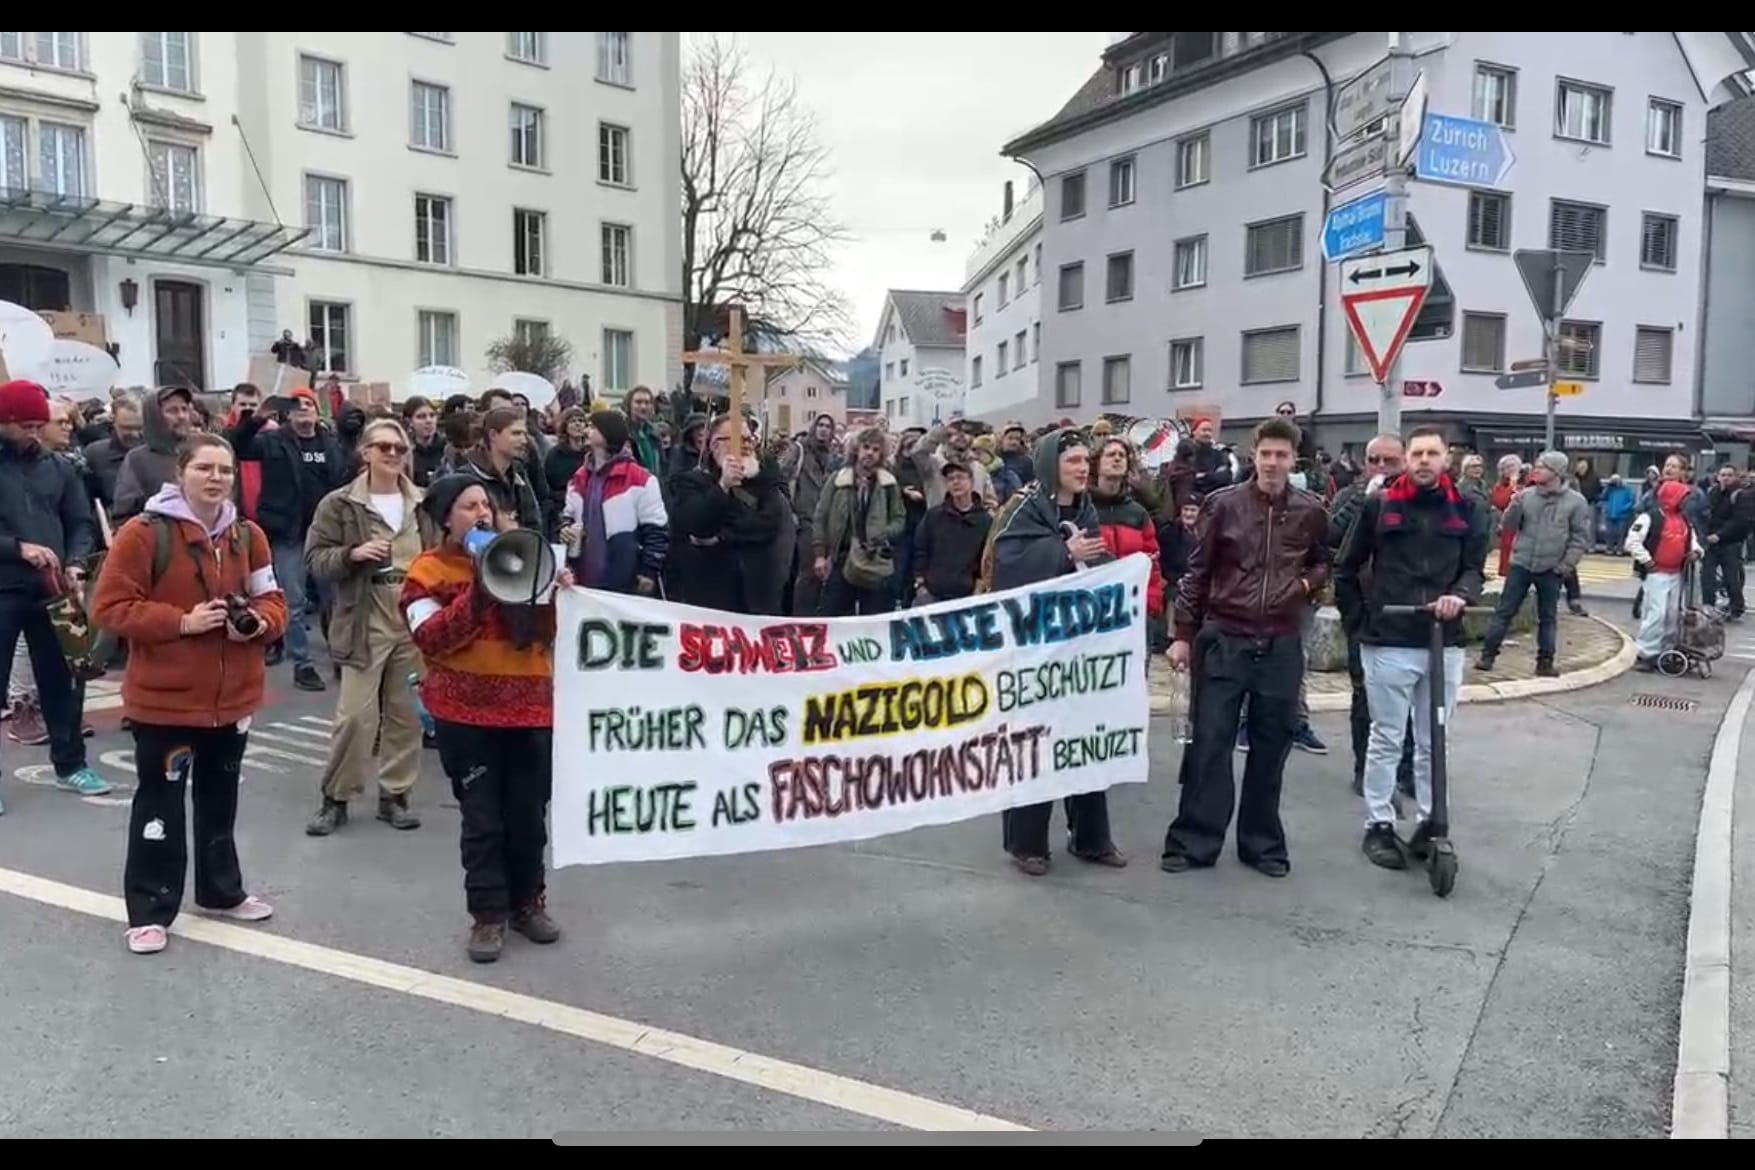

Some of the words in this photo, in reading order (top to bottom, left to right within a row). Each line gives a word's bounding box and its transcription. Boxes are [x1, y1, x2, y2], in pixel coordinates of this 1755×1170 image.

[1430, 149, 1489, 180] Luzern
[1431, 120, 1487, 151] Zürich
[578, 619, 671, 671] DIE
[678, 623, 837, 674] SCHWEIZ
[837, 639, 882, 664] UND
[890, 603, 1004, 661] ALICE
[588, 704, 706, 751] FRÜHER
[724, 705, 788, 748] DAS
[803, 673, 988, 742] NAZIGOLD
[997, 651, 1132, 711] BESCHÜTZT
[588, 780, 697, 835] HEUTE
[711, 782, 761, 826] ALS
[1053, 725, 1143, 771] BENÜTZT
